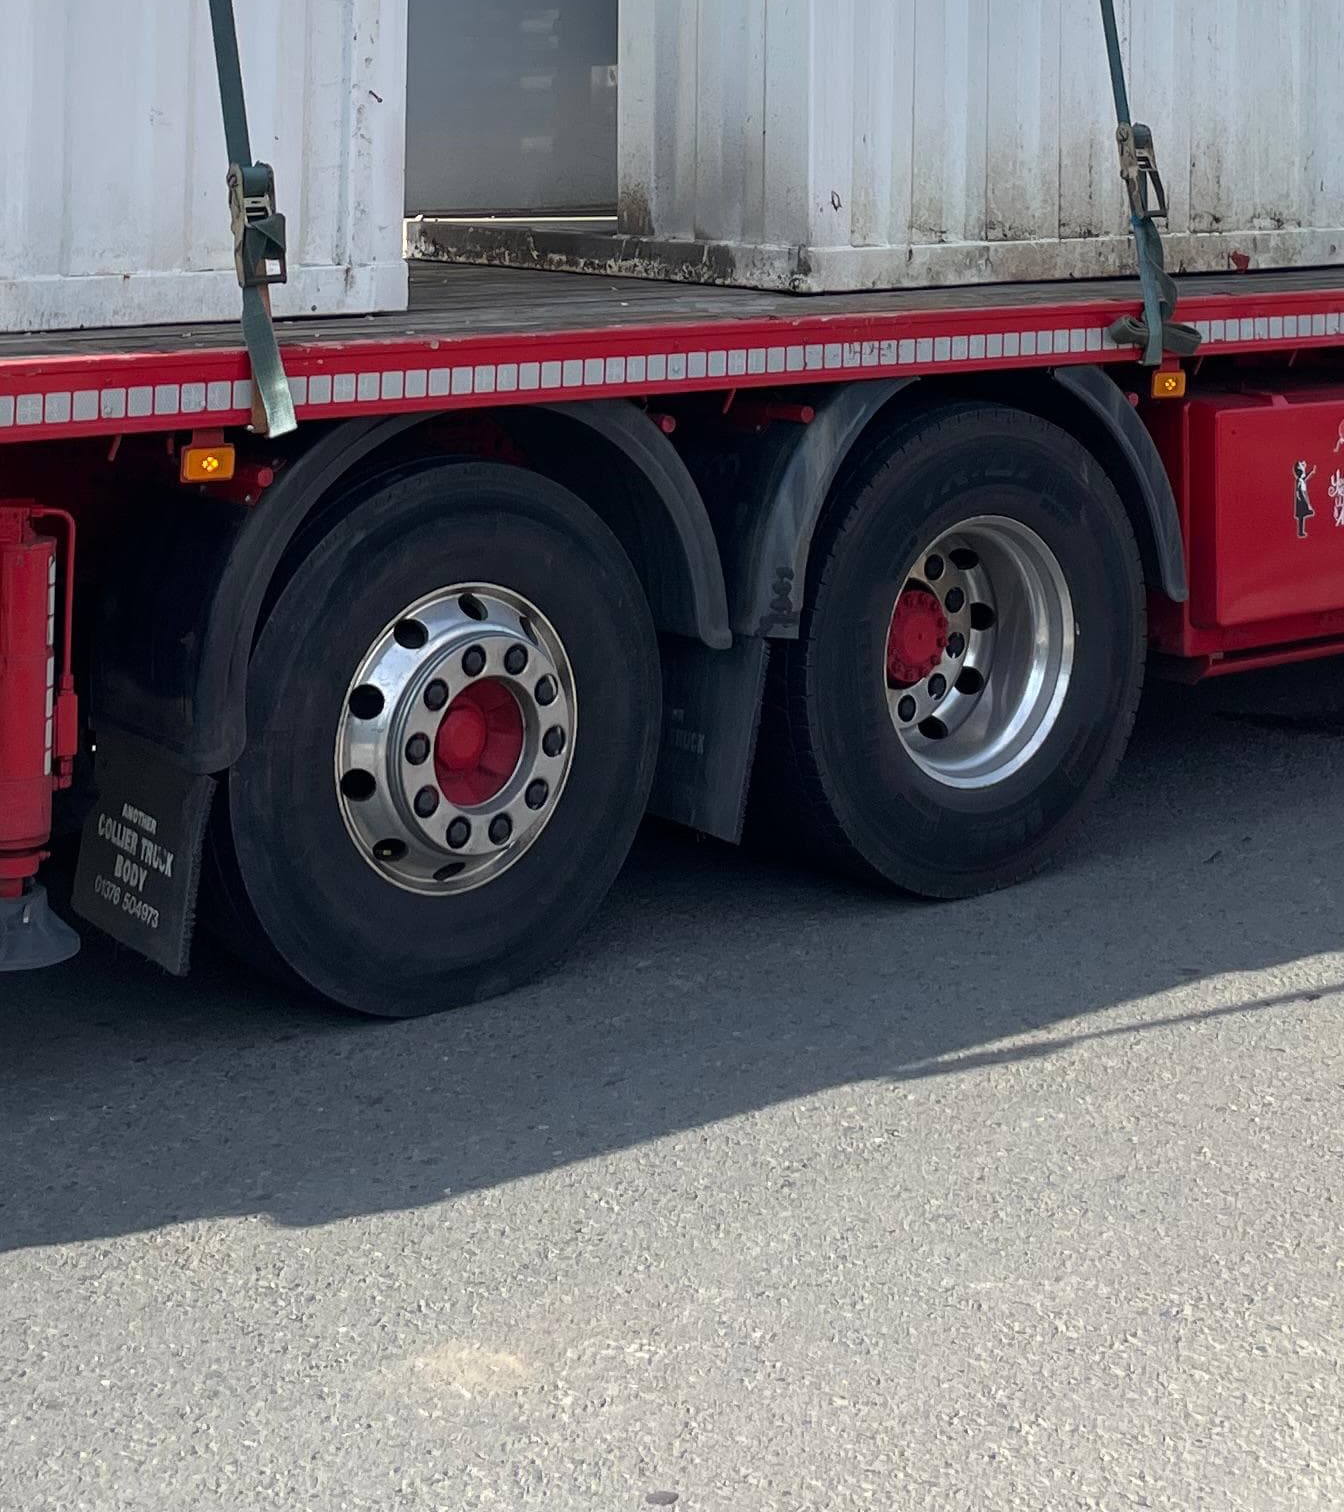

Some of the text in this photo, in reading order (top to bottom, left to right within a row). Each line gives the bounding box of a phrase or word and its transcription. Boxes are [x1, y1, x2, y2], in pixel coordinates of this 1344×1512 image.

[98, 813, 138, 856] COLLIER
[122, 803, 157, 835] ANOTHER
[114, 854, 148, 892] BODY
[122, 892, 160, 928] 504973
